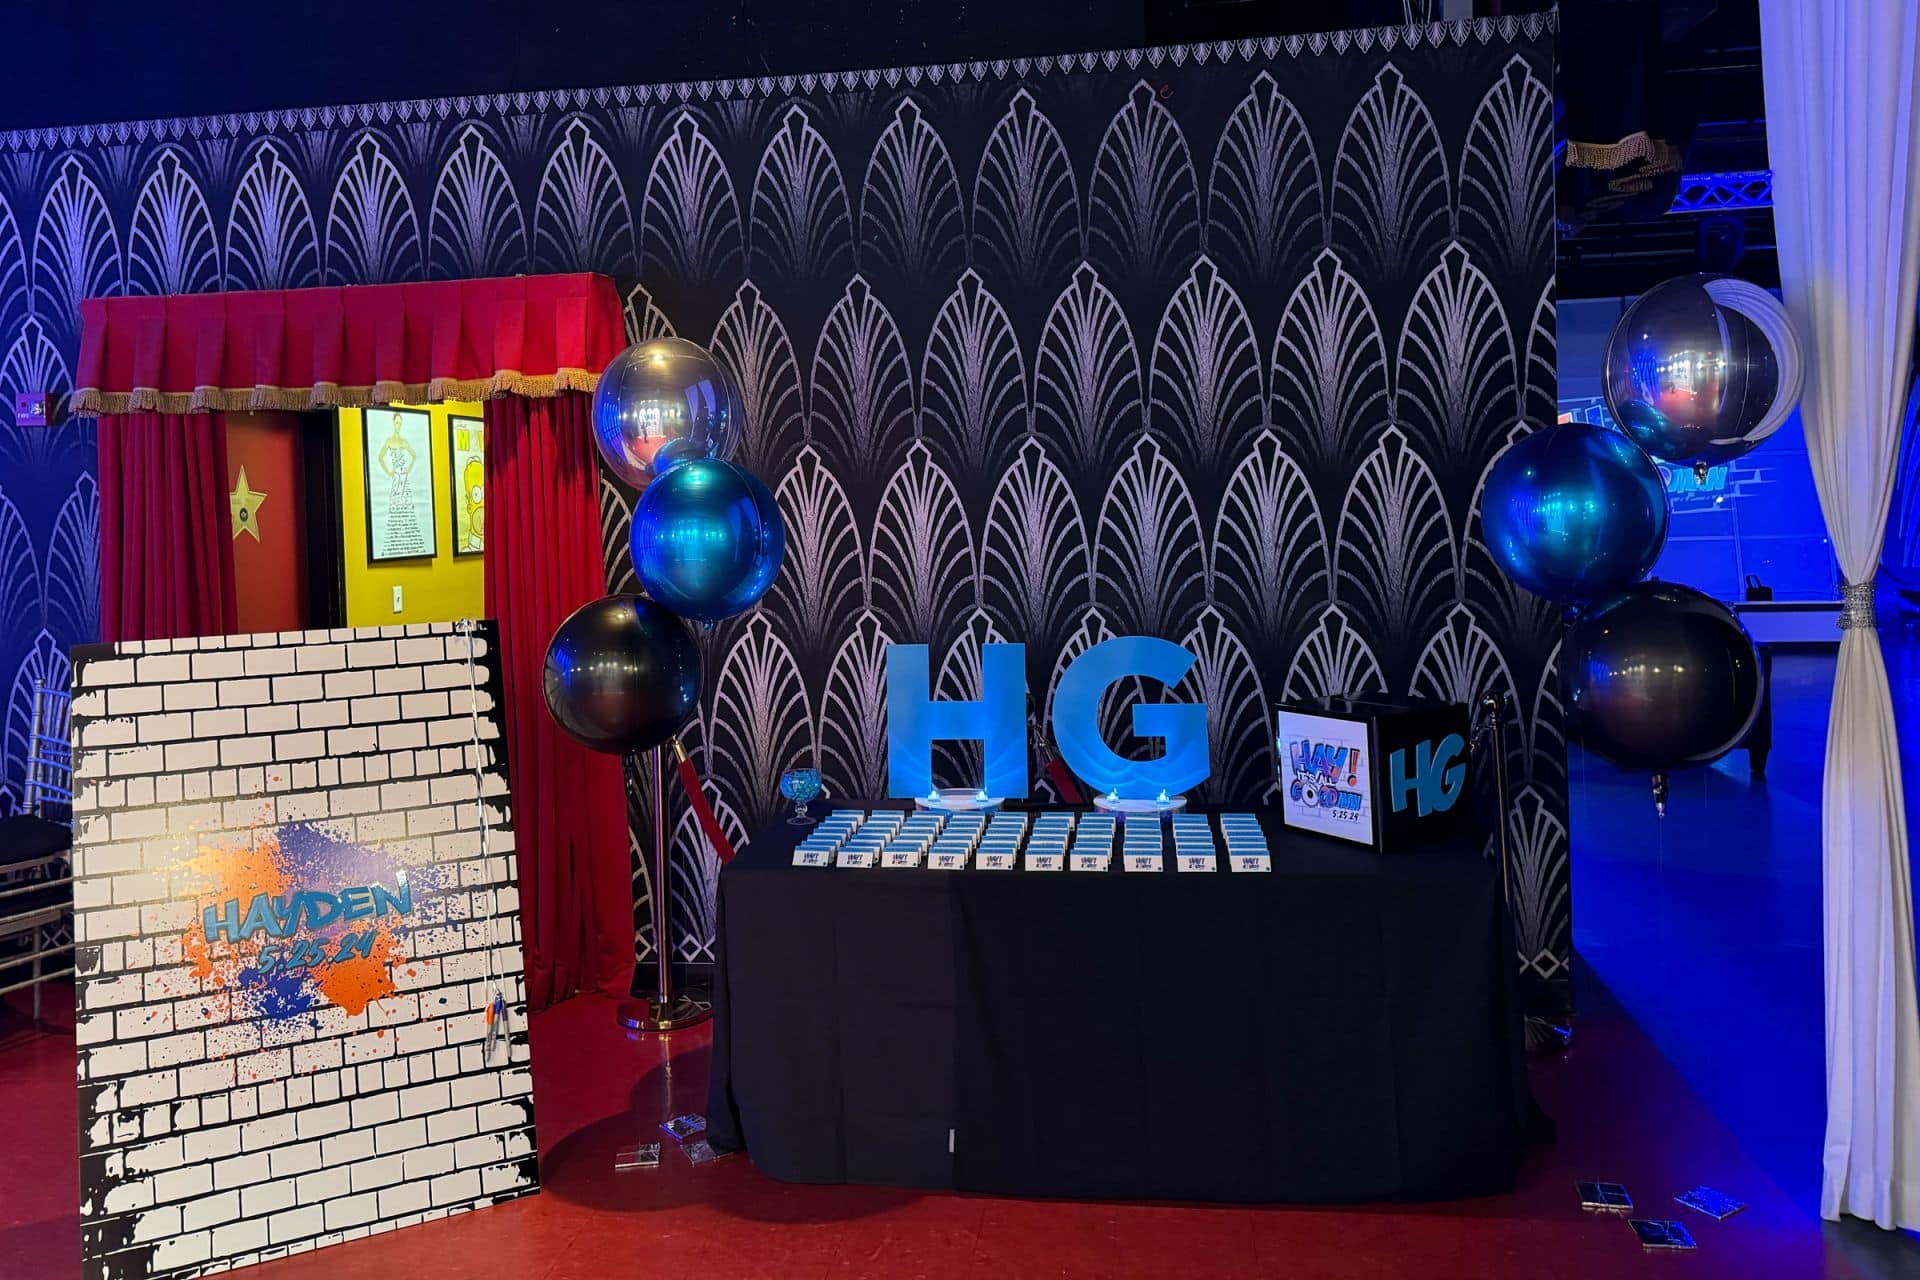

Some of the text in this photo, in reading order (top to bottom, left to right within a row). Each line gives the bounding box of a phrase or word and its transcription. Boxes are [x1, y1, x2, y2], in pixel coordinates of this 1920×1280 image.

[1317, 772, 1336, 787] ALL
[1389, 733, 1467, 818] HG
[202, 869, 412, 945] HAYDEN
[257, 929, 378, 976] 5.25.24
